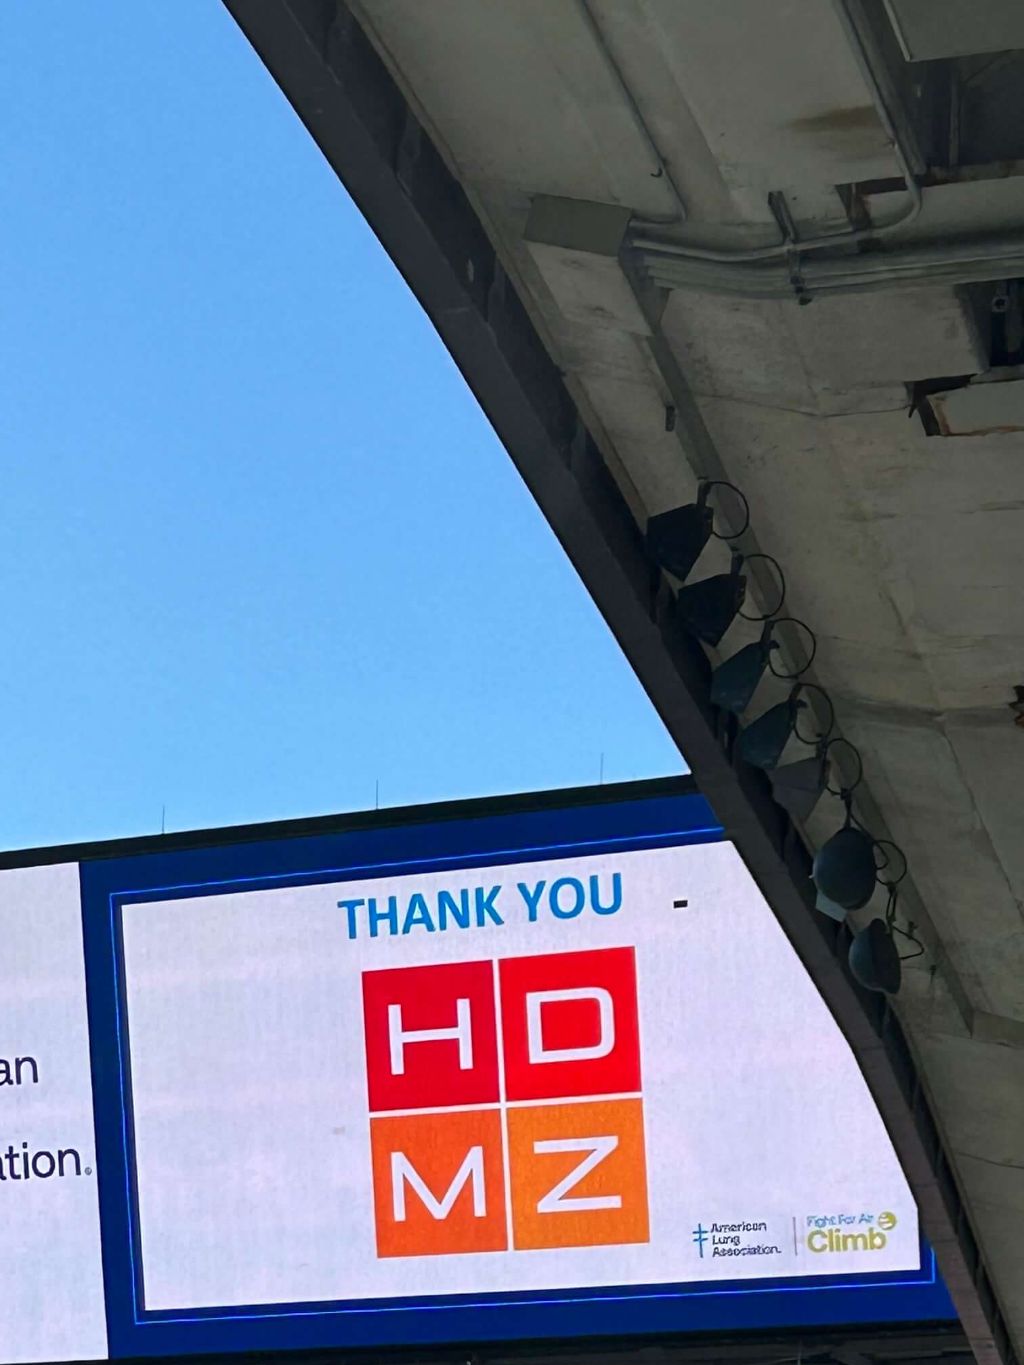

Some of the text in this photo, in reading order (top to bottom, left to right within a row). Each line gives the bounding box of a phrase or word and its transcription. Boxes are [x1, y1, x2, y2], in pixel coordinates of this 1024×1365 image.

[337, 872, 622, 939] THANK YOU
[710, 1221, 767, 1234] American
[712, 1235, 741, 1246] Lung
[807, 1227, 887, 1254] Climb
